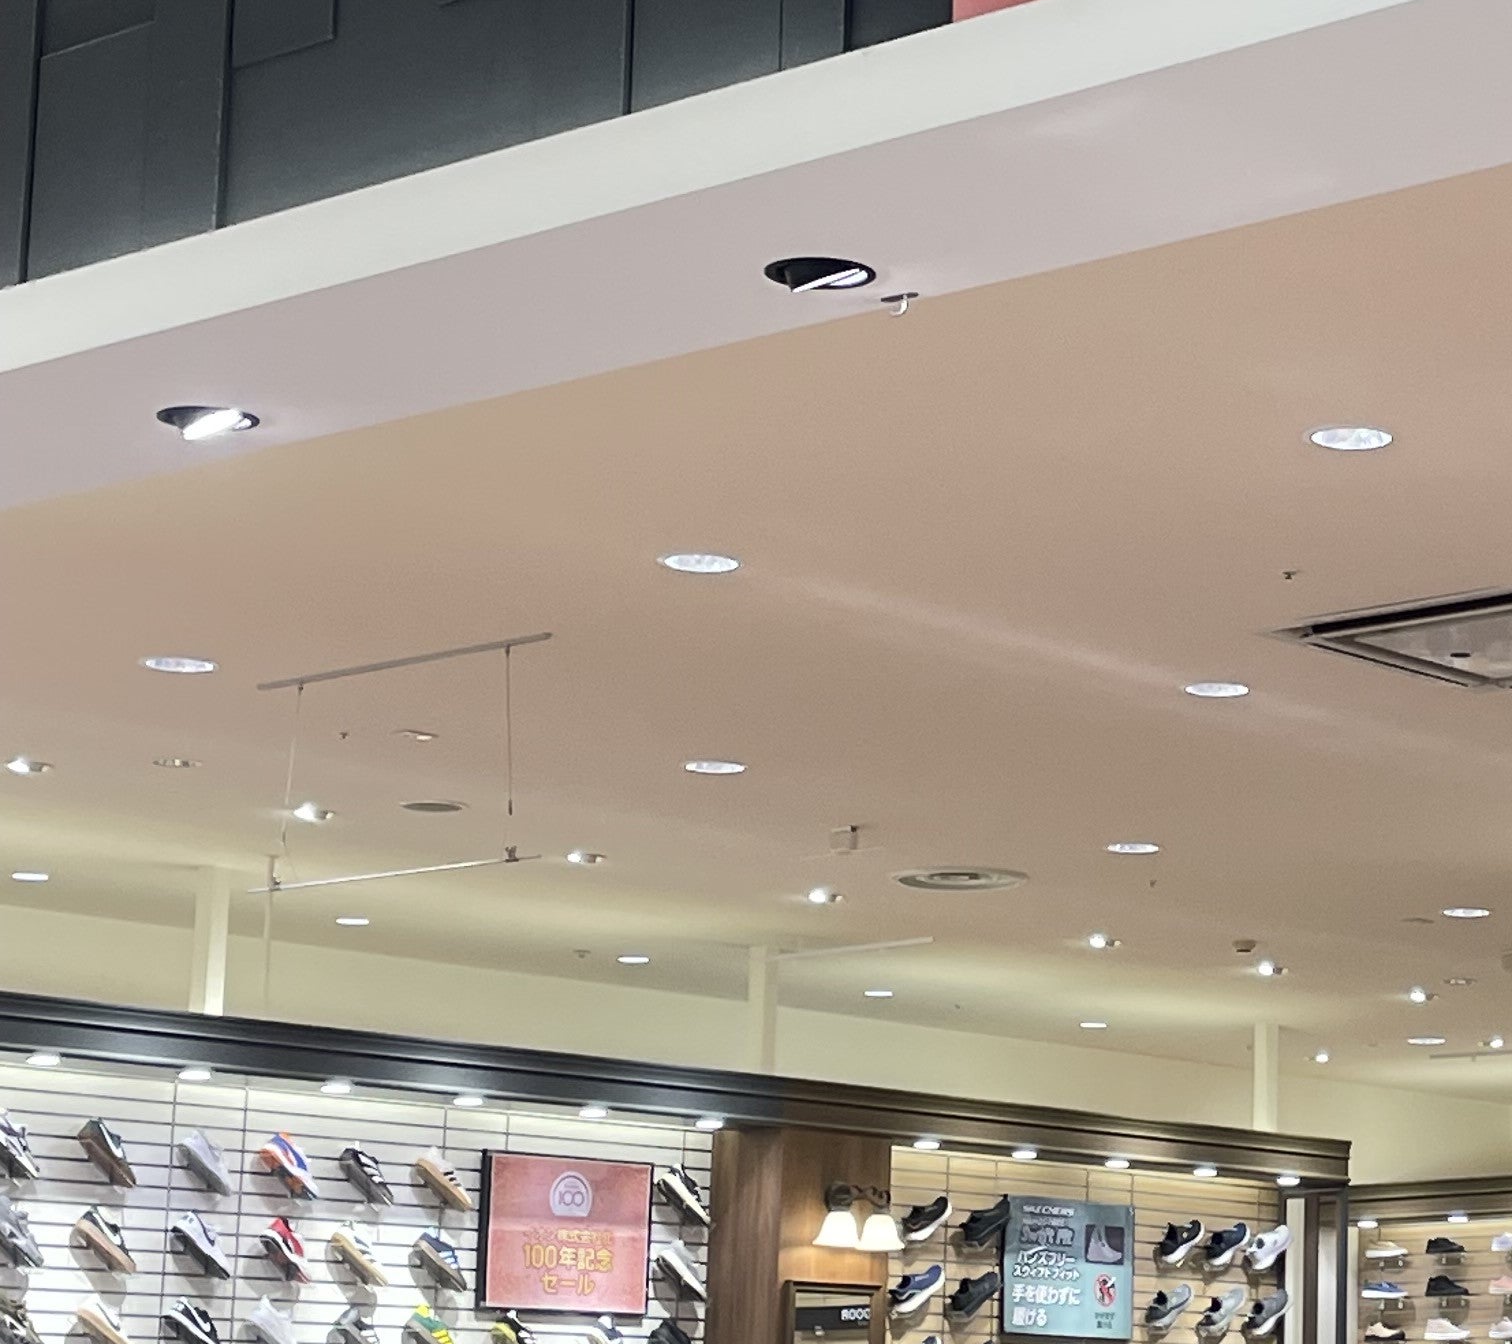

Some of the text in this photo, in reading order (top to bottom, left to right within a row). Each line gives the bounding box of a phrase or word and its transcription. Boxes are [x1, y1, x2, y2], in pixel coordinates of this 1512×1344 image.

[523, 1243, 613, 1272] 100年記念
[541, 1272, 596, 1295] セール
